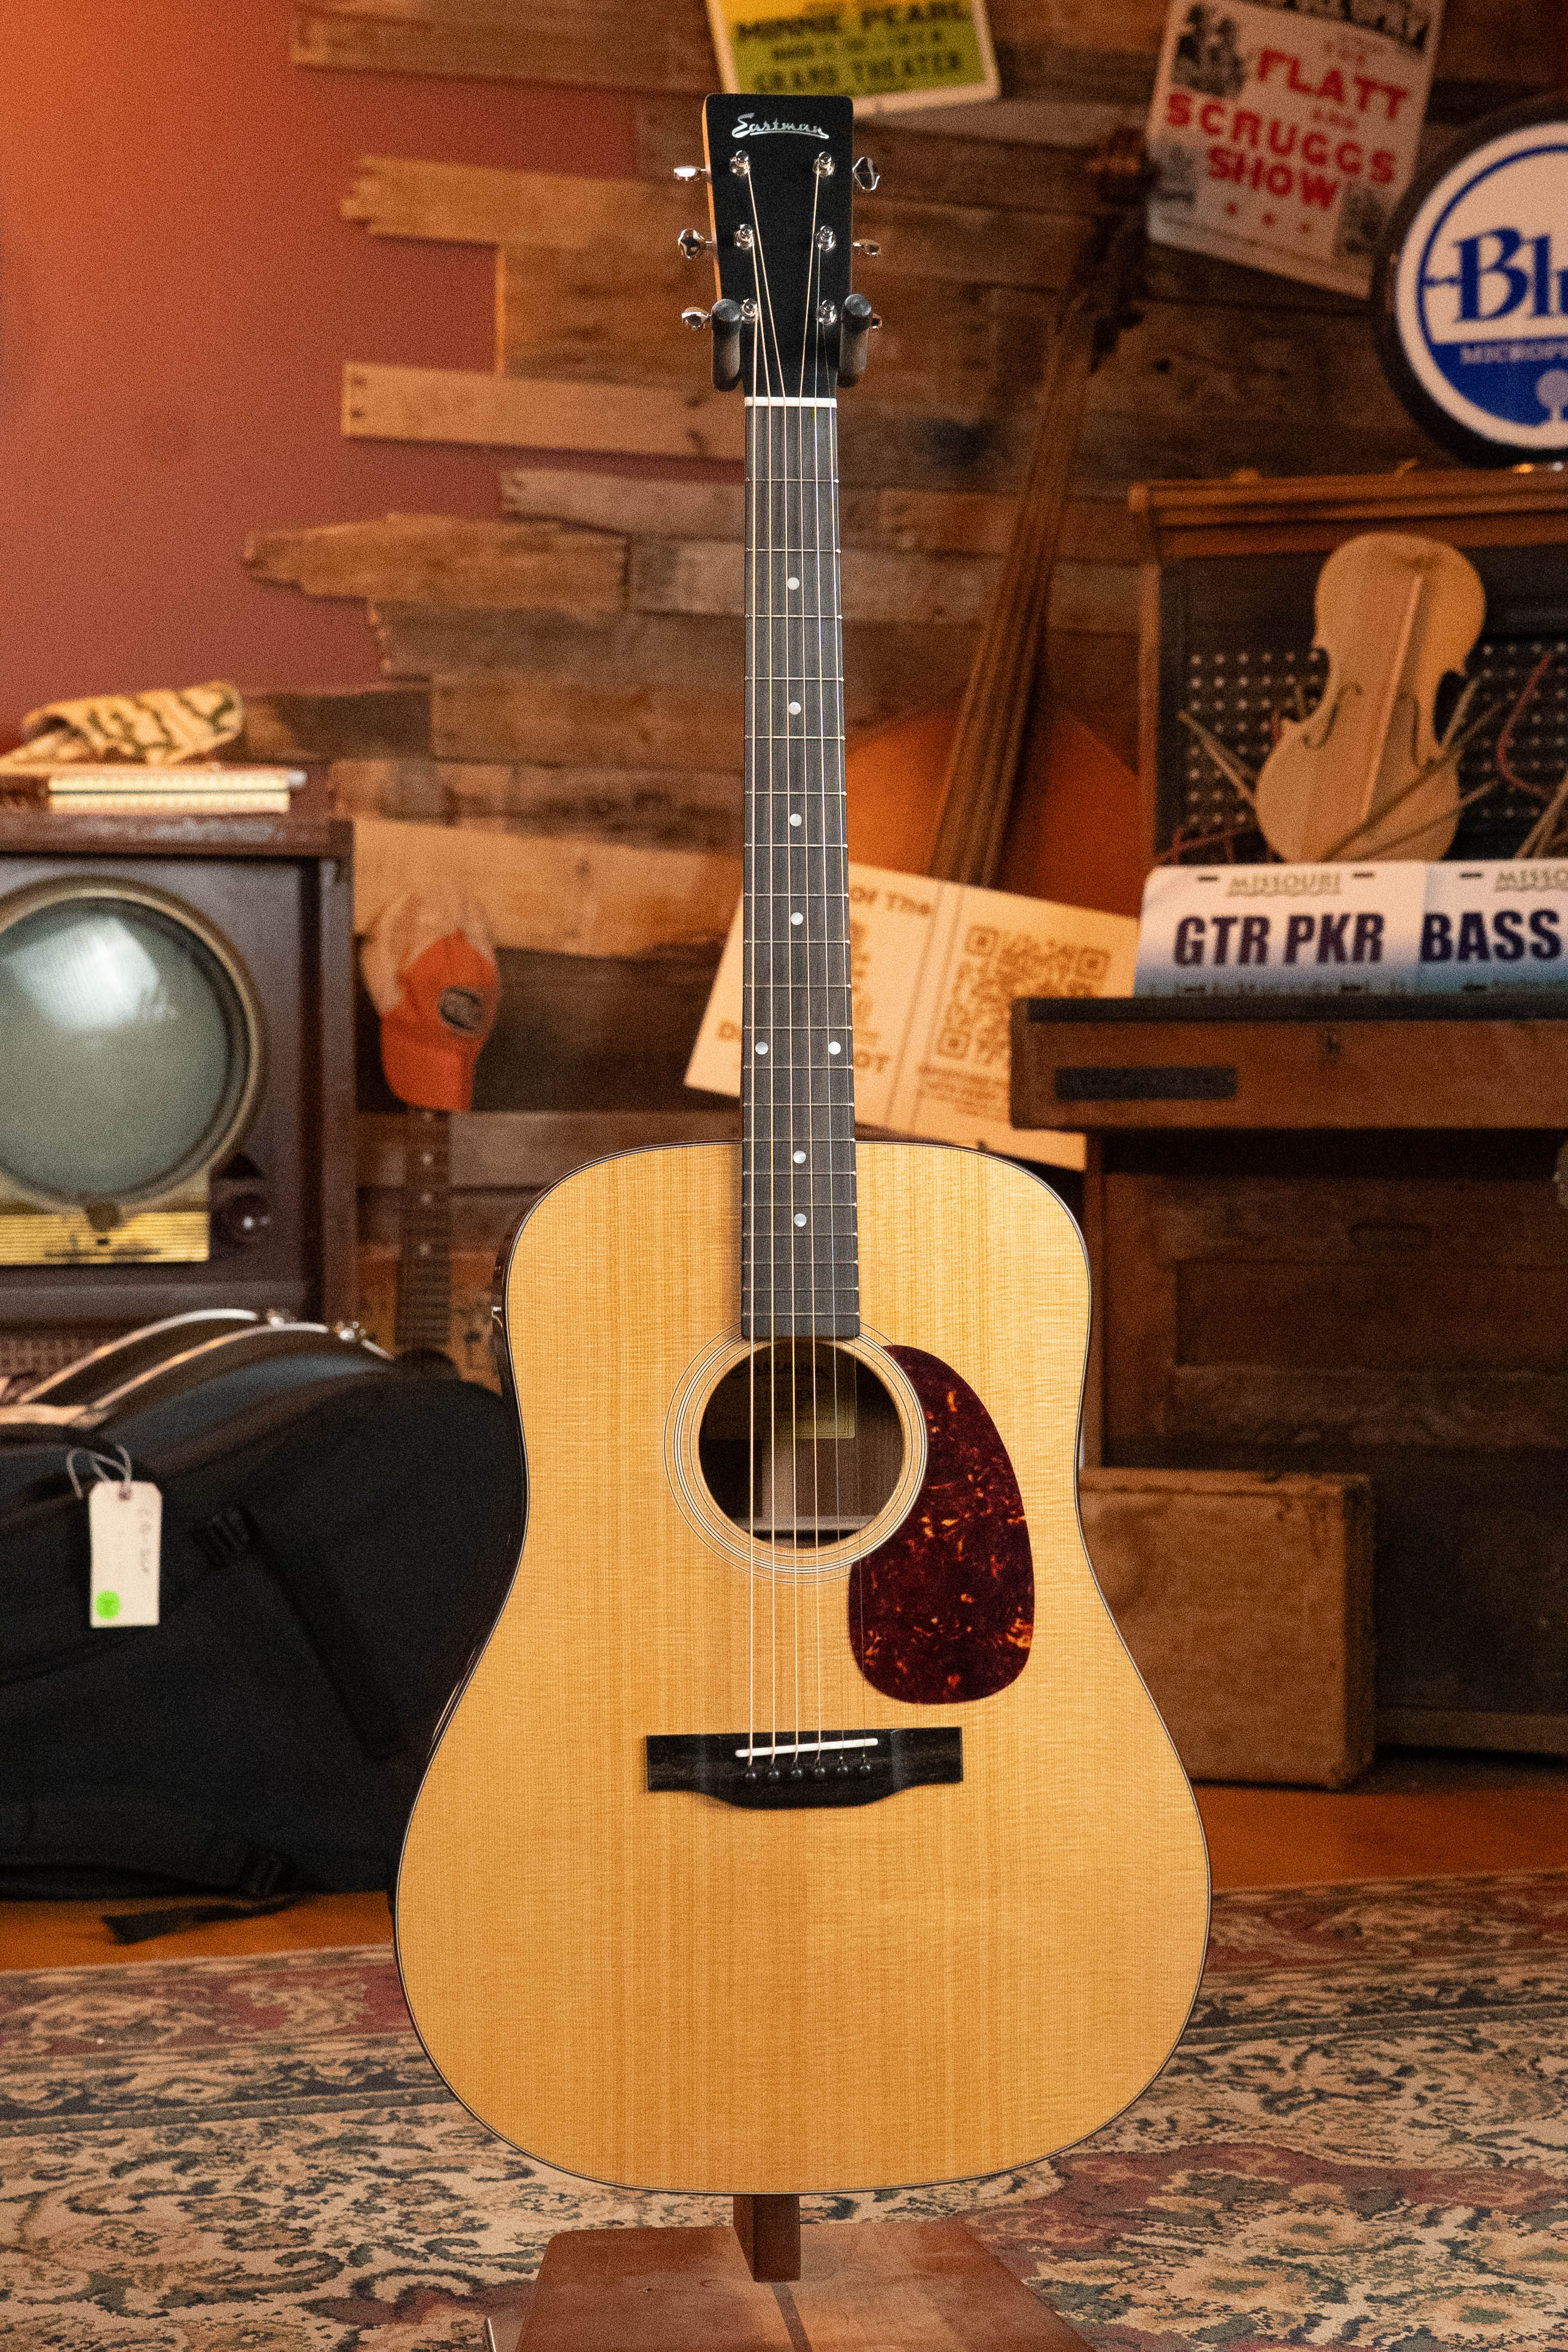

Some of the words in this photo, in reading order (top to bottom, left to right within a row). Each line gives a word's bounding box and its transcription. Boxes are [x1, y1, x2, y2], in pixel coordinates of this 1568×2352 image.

[1258, 48, 1408, 120] FLATT
[731, 112, 830, 140] Eastman
[1167, 93, 1395, 185] SCRUGGS
[1207, 146, 1339, 210] SHOW
[886, 892, 932, 917] The
[1227, 872, 1341, 896] MISSOURI
[1173, 915, 1270, 968] GTR
[1282, 913, 1385, 967] PKR
[1418, 909, 1561, 964] BASS
